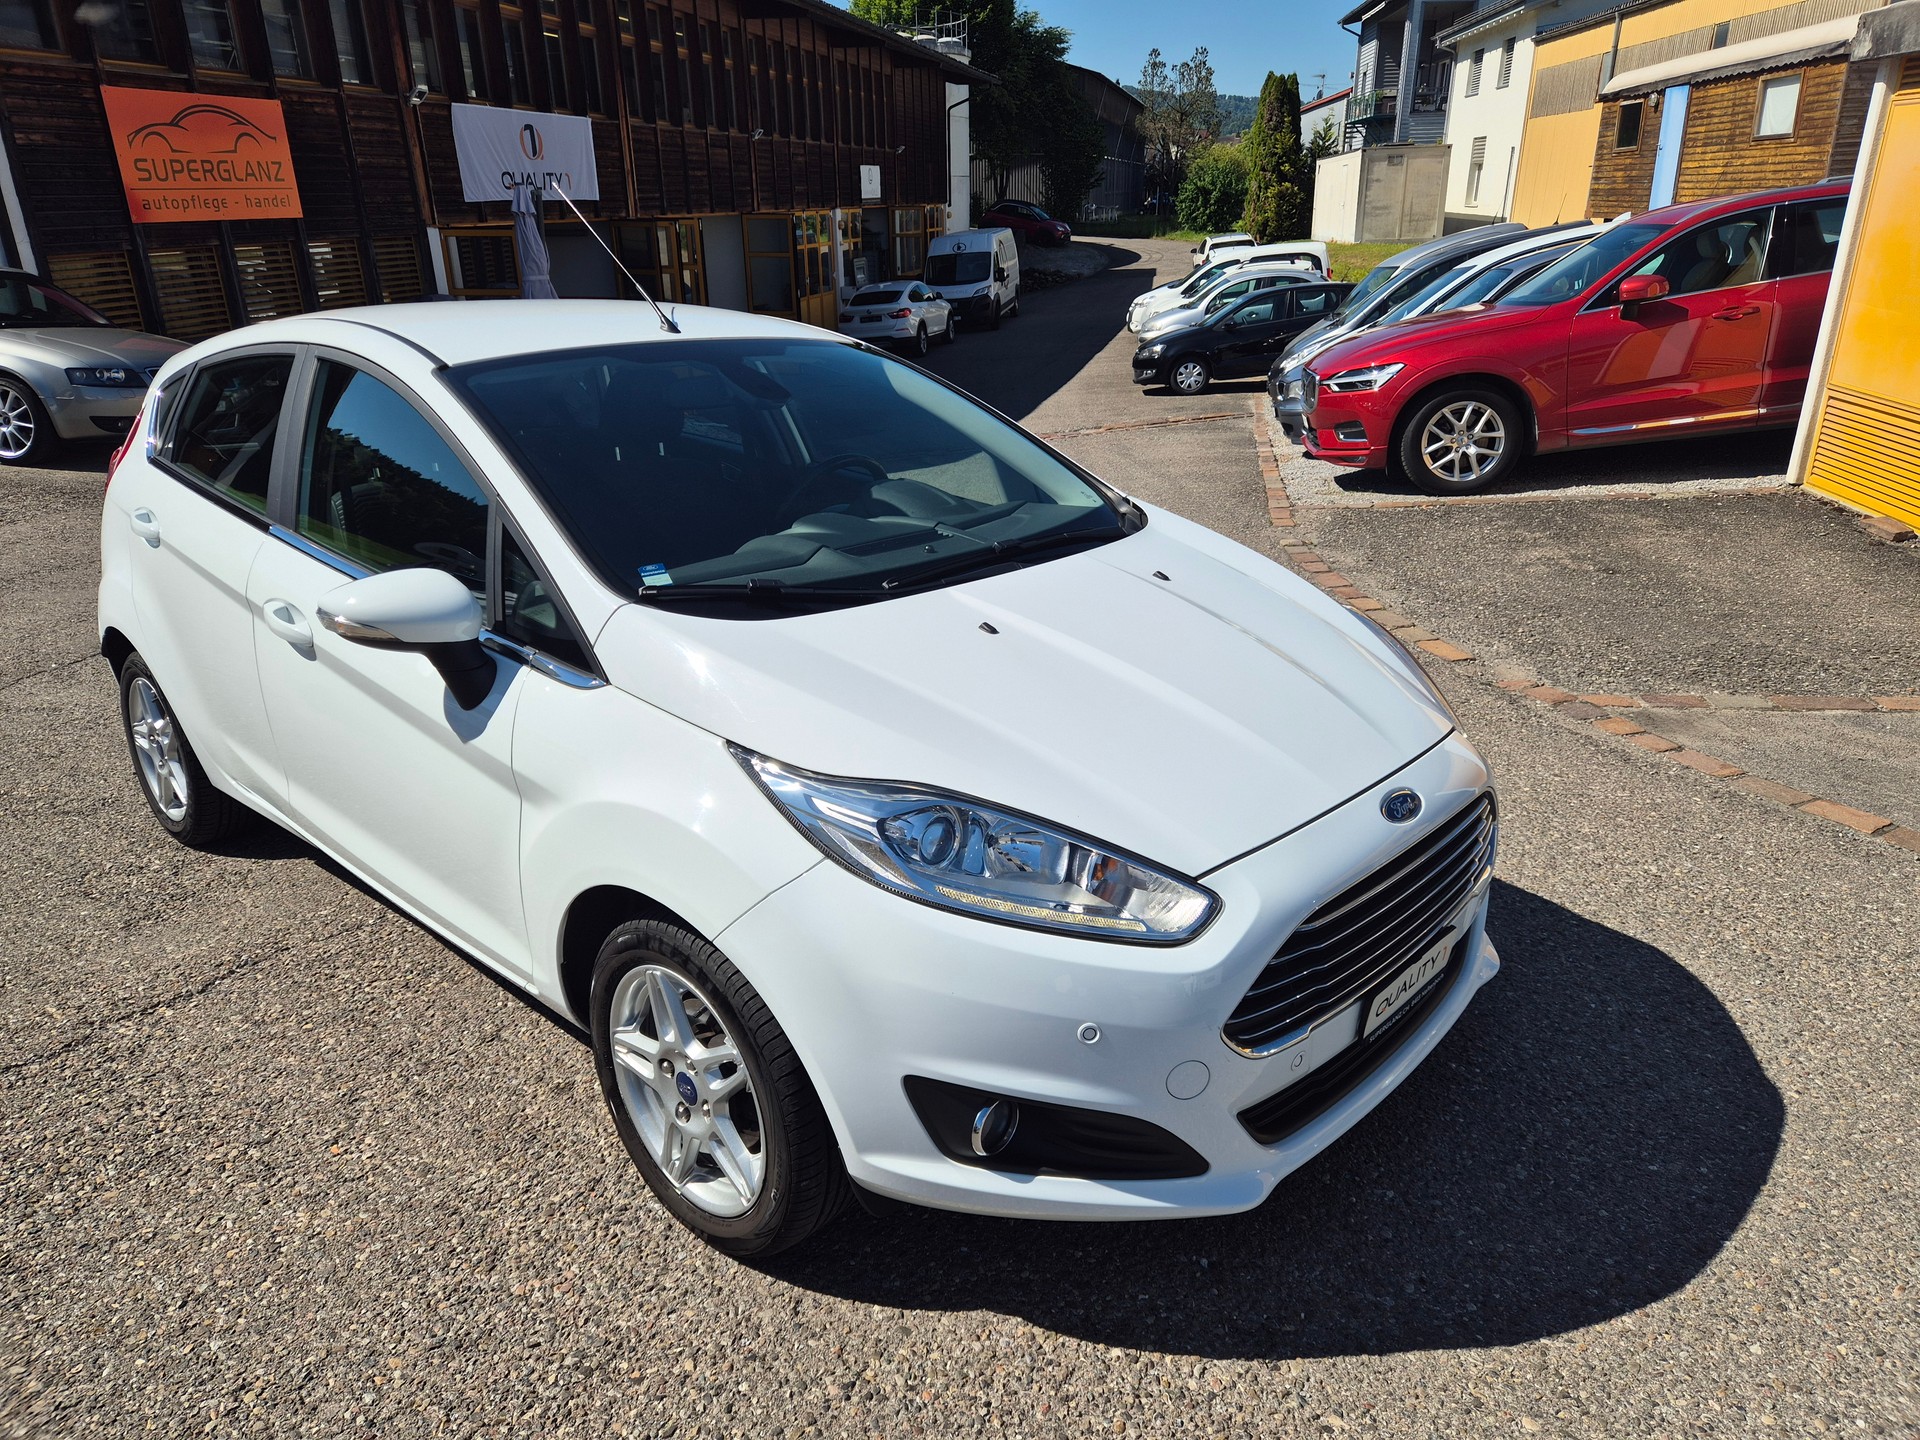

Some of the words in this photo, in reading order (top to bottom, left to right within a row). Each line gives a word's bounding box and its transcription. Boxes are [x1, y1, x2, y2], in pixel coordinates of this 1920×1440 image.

[133, 158, 285, 182] SUPERGLANZ
[142, 194, 228, 212] autopflege
[245, 194, 291, 208] handel
[1390, 796, 1418, 818] Ford
